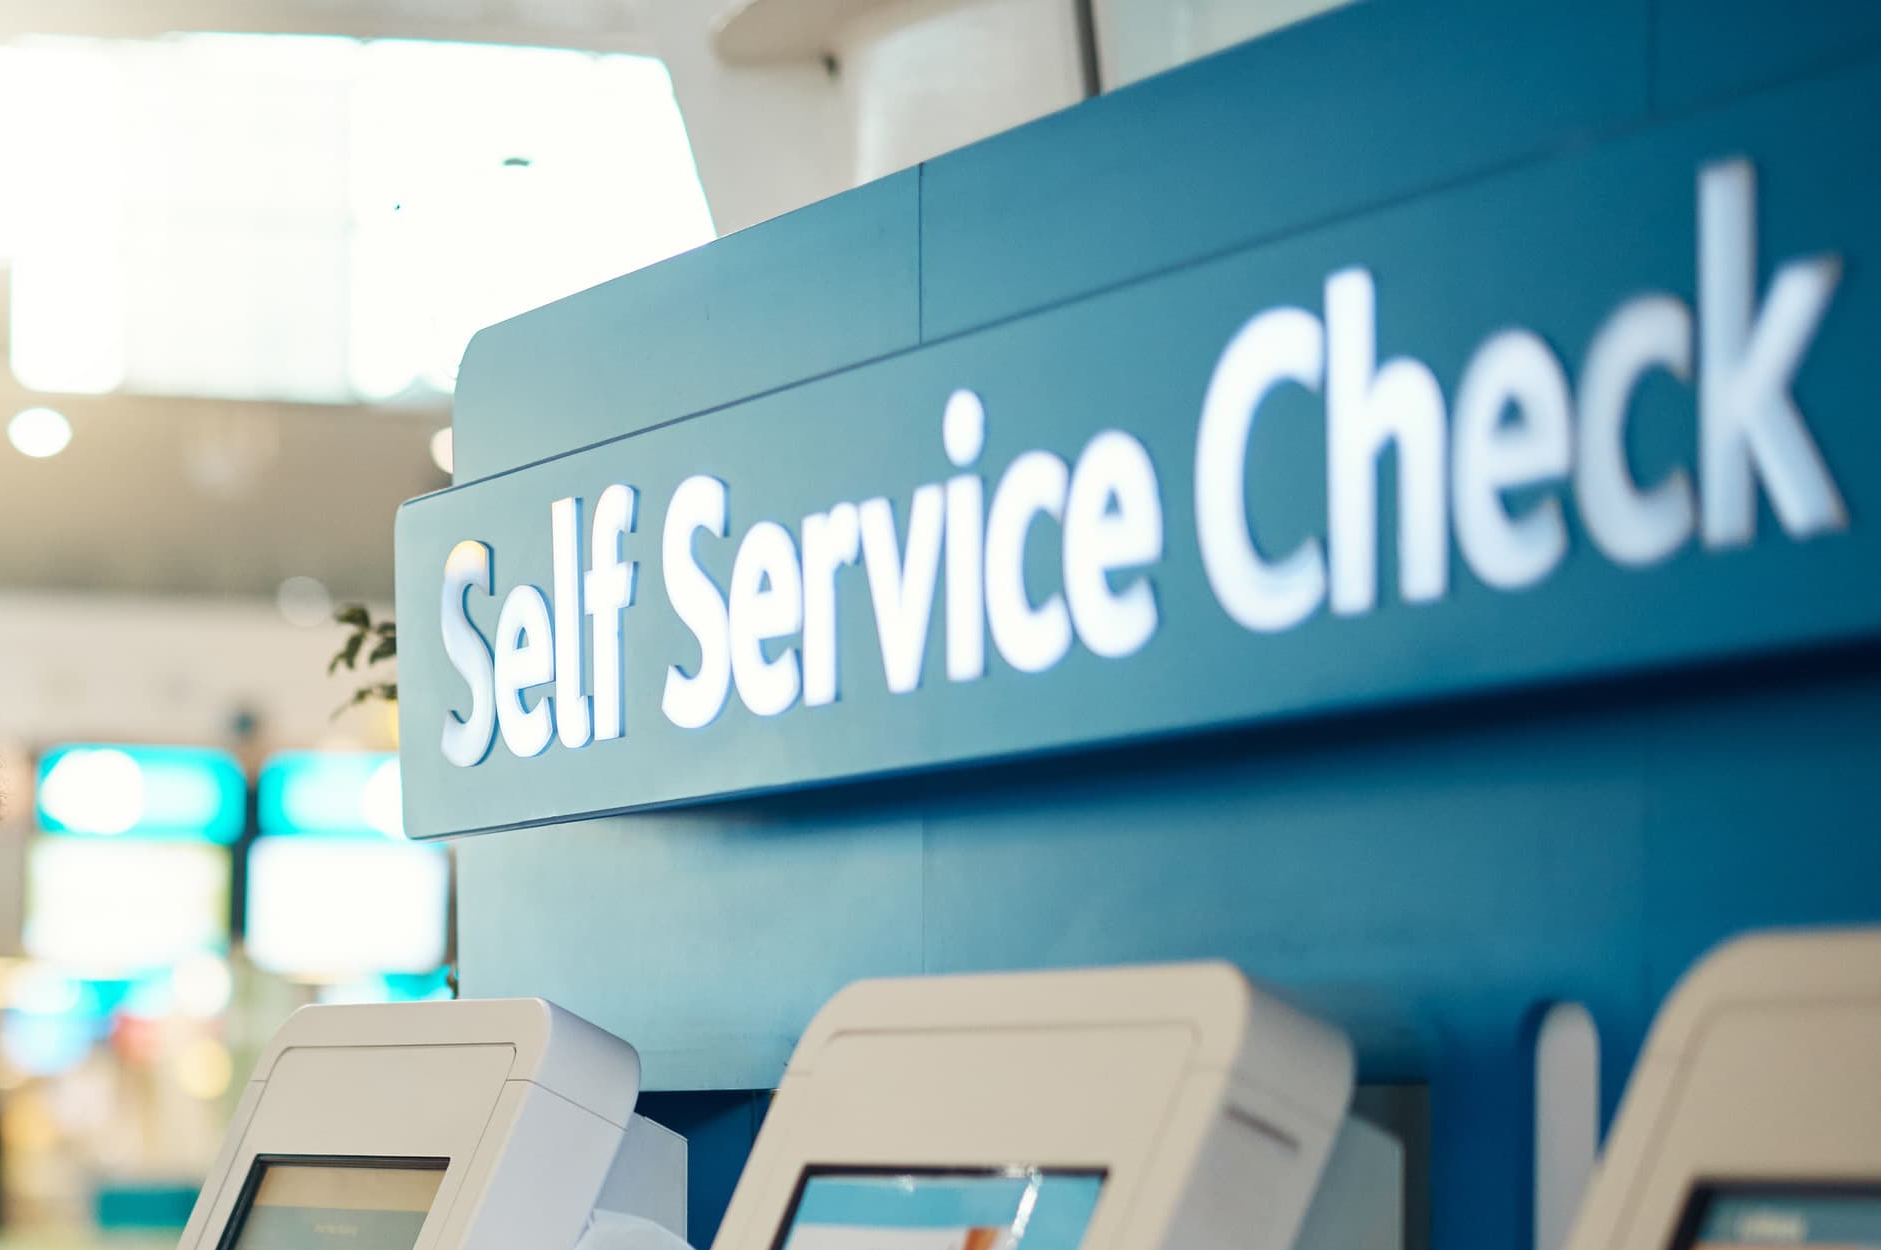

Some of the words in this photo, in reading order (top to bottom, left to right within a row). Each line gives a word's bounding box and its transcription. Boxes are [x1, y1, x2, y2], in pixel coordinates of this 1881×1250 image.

[440, 482, 640, 768] Self
[662, 388, 1163, 729] Service
[1193, 154, 1851, 633] Check
